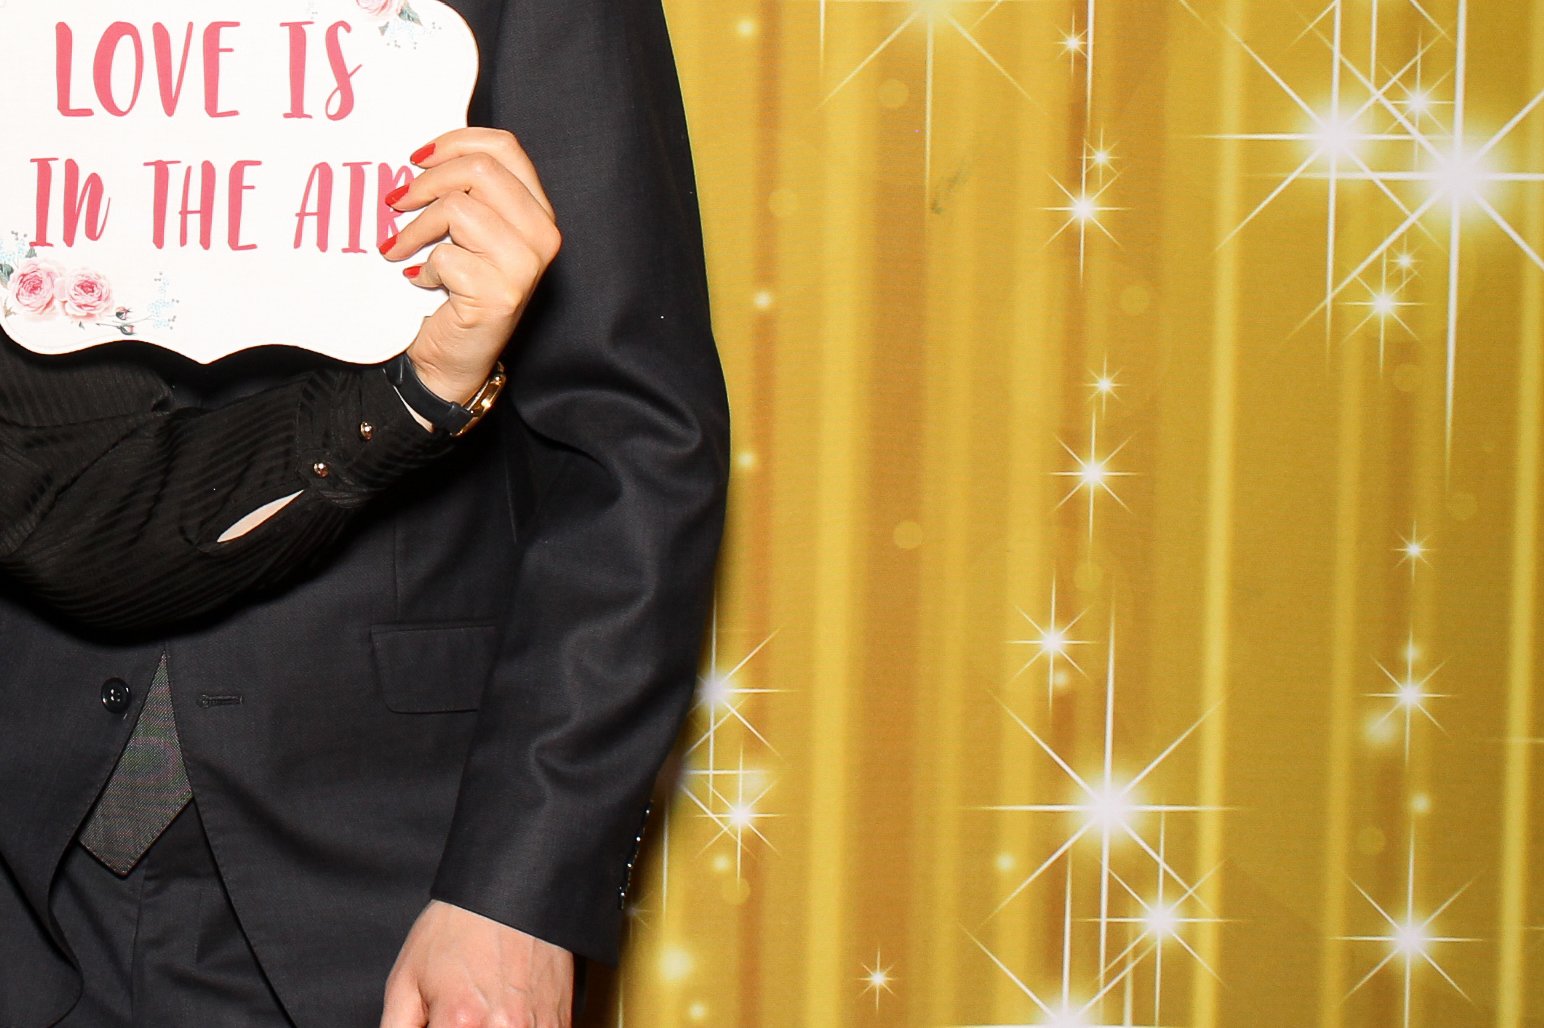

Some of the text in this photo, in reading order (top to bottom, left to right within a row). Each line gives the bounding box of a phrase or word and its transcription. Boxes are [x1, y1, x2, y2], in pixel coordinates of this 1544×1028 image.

[56, 20, 363, 121] LOVE IS
[143, 159, 263, 252] THE
